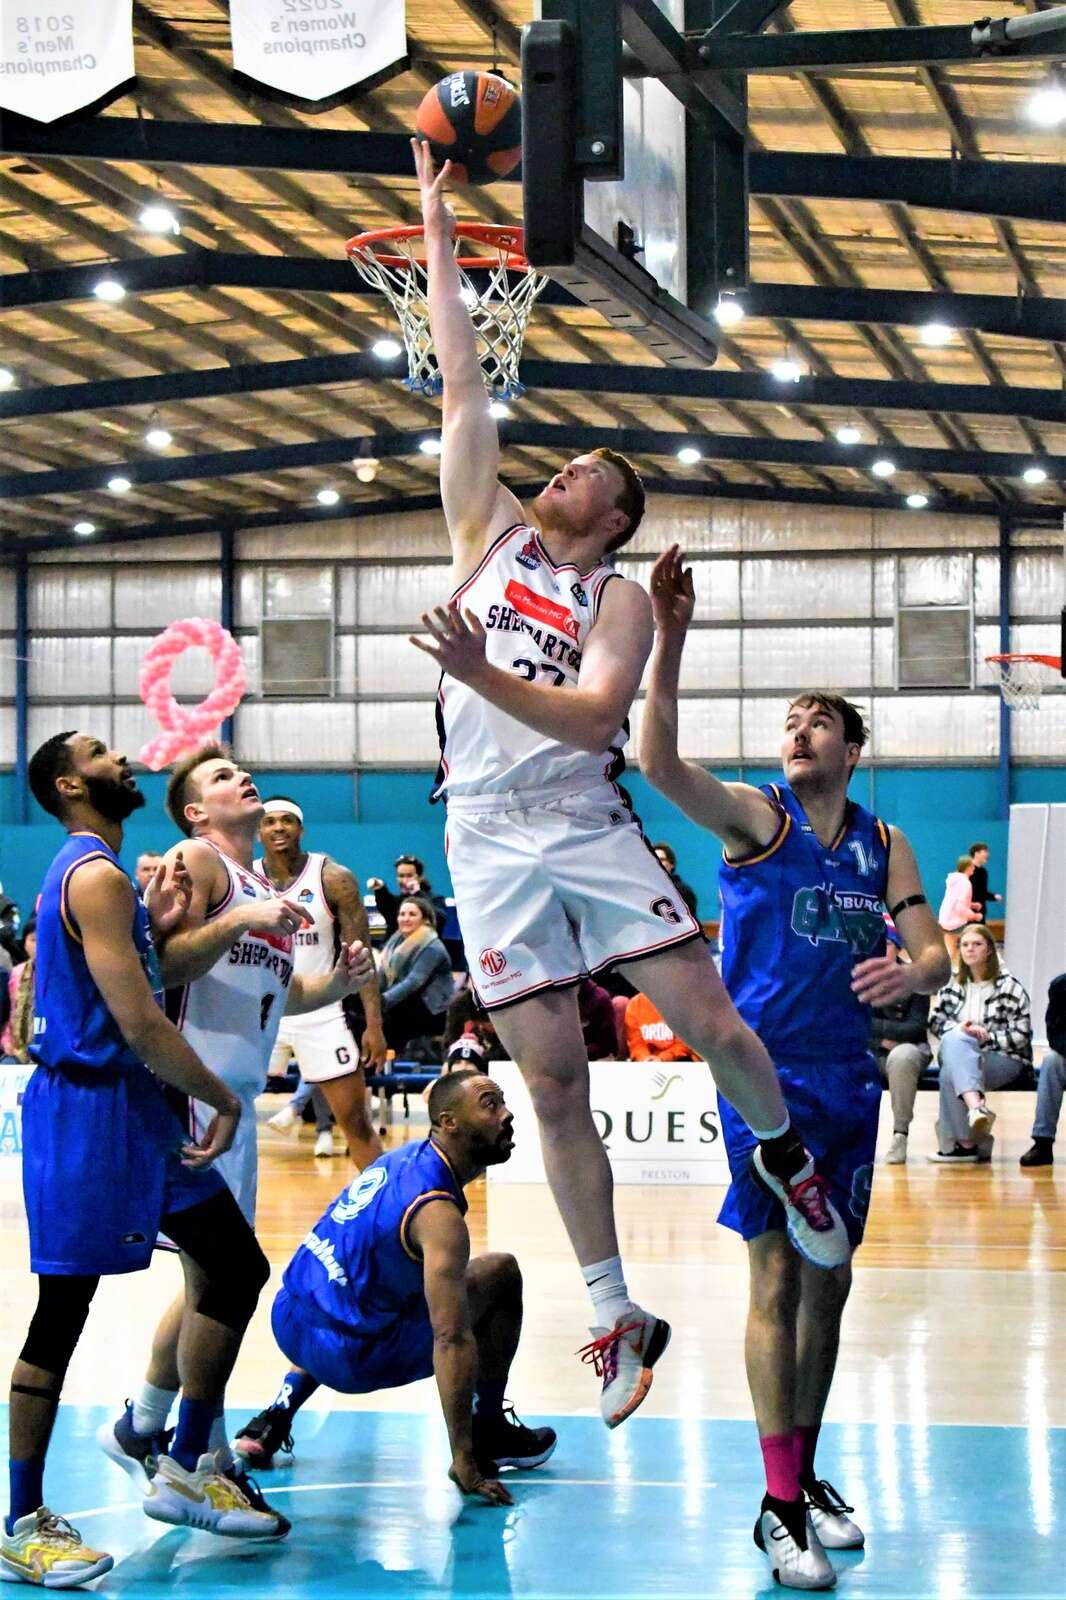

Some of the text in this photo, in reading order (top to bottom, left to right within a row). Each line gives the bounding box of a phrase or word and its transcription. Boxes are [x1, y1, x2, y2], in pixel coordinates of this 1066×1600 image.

[651, 897, 682, 924] G
[480, 949, 505, 975] MG
[335, 1046, 350, 1065] G
[641, 1169, 691, 1181] PRESTON
[330, 1166, 389, 1225] 9
